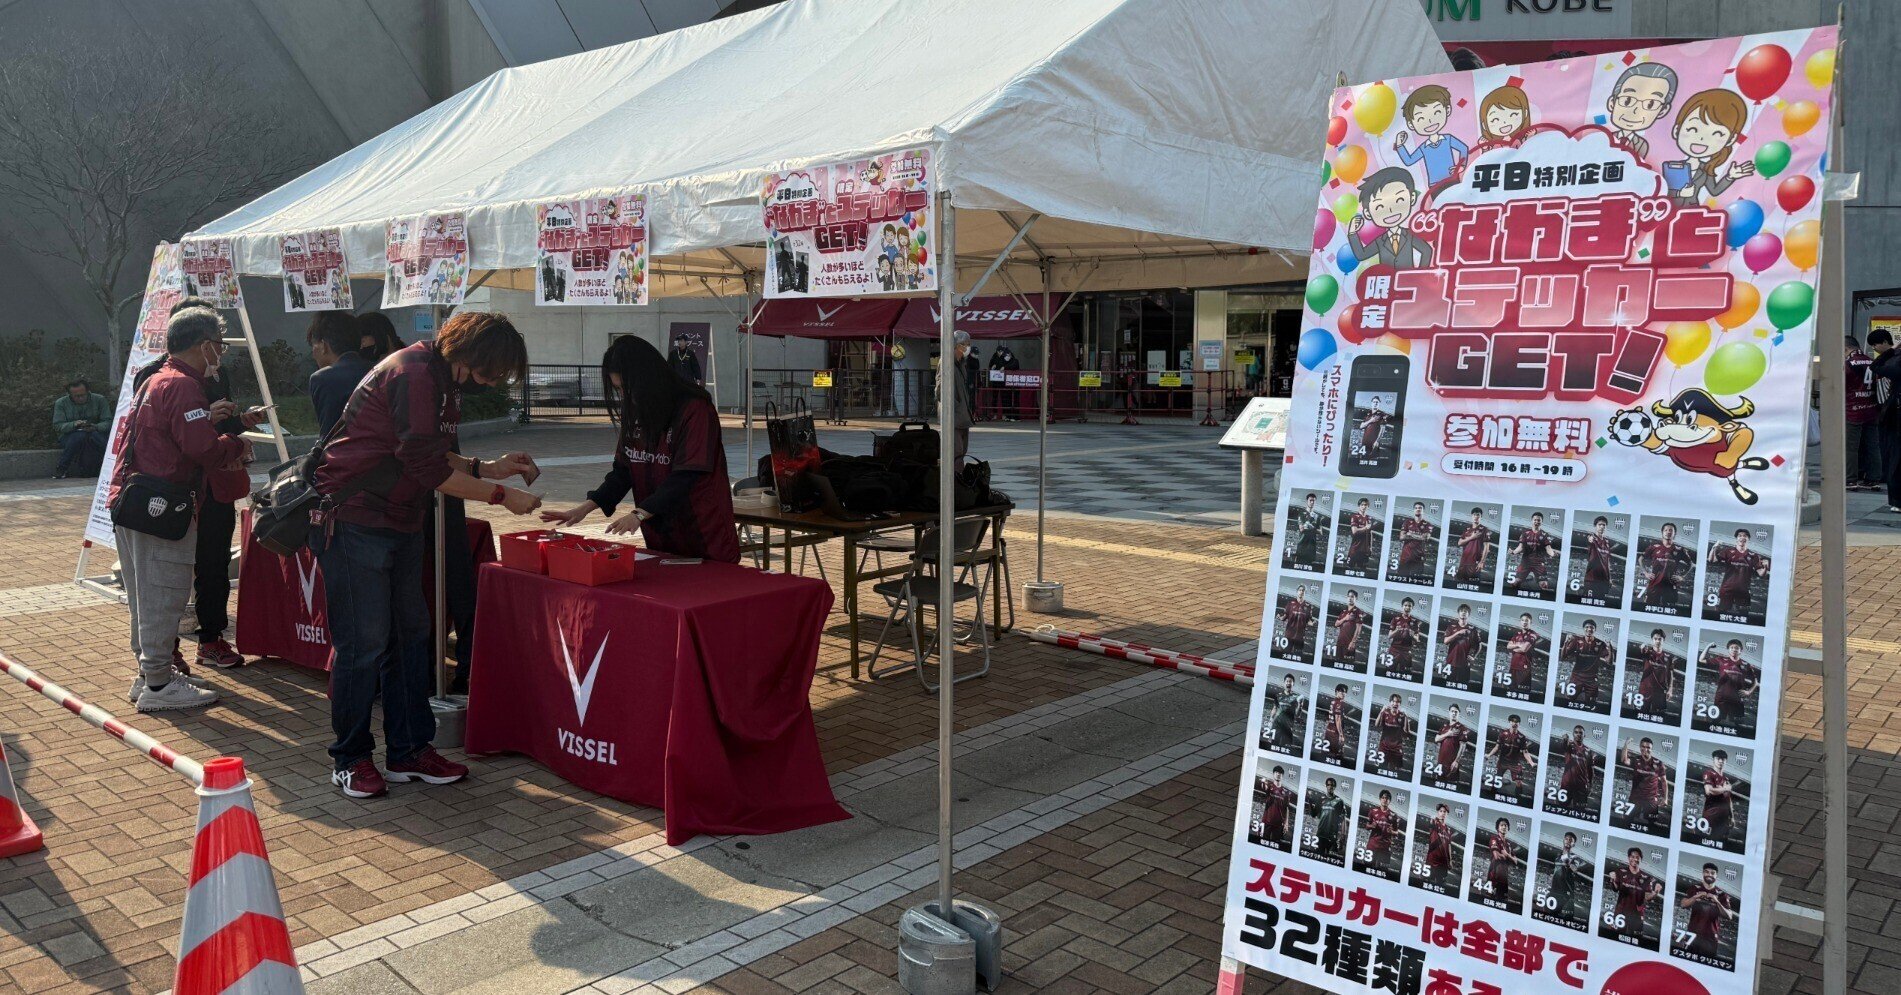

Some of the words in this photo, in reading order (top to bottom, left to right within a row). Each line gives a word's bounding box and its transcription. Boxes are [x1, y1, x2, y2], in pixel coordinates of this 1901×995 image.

[1471, 160, 1626, 194] 平日特別企画
[813, 221, 869, 250] GET!
[1411, 195, 1727, 265] “なかま”と
[572, 247, 610, 271] GET!
[820, 261, 865, 274] 人数が多いほど
[1360, 275, 1391, 330] 限定
[1389, 264, 1730, 329] ステッカー
[955, 309, 1034, 322] VISSEL
[1428, 329, 1665, 395] GET!
[1445, 416, 1591, 454] 参加無料
[1351, 445, 1367, 456] 24
[1453, 459, 1495, 472] 受付時間
[1285, 548, 1292, 558] 1
[1336, 553, 1345, 565] 2
[1390, 559, 1400, 571] 3
[1447, 566, 1458, 577] 4
[1506, 572, 1517, 584] 5
[1570, 579, 1581, 591] 6
[1635, 586, 1648, 599] 7
[1706, 593, 1719, 607] 9
[295, 622, 327, 645] VISSEL
[1274, 636, 1289, 649] 10
[1325, 644, 1338, 657] 11
[1379, 653, 1394, 667] 13
[1436, 662, 1452, 676] 14
[1495, 672, 1513, 686] 15
[1558, 682, 1577, 697] 16
[1567, 701, 1597, 711] カエターノ
[1625, 692, 1645, 707] 18
[1696, 703, 1720, 719] 20
[1262, 727, 1277, 740] 21
[557, 727, 618, 766] VISSEL
[1314, 738, 1331, 752] 22
[1368, 750, 1386, 763] 23
[1424, 761, 1443, 776] 24
[1484, 773, 1503, 789] 25
[1548, 779, 1559, 787] FW
[1547, 786, 1568, 803] 26
[1614, 800, 1636, 816] 27
[1251, 820, 1265, 835] 31
[1685, 815, 1709, 832] 30
[1303, 833, 1320, 848] 32
[1356, 847, 1374, 863] 33
[1414, 854, 1425, 862] FW
[1412, 861, 1431, 878] 35
[1472, 877, 1494, 894] 44
[1537, 886, 1548, 894] GK
[1535, 893, 1558, 911] 50
[1604, 903, 1615, 911] DF
[1245, 857, 1589, 990] ステッカーは全部で
[1603, 911, 1626, 928] 66
[1676, 920, 1688, 929] MF
[1674, 928, 1698, 947] 77
[1672, 948, 1699, 961] グスタボ
[1699, 955, 1734, 970] クリスマン
